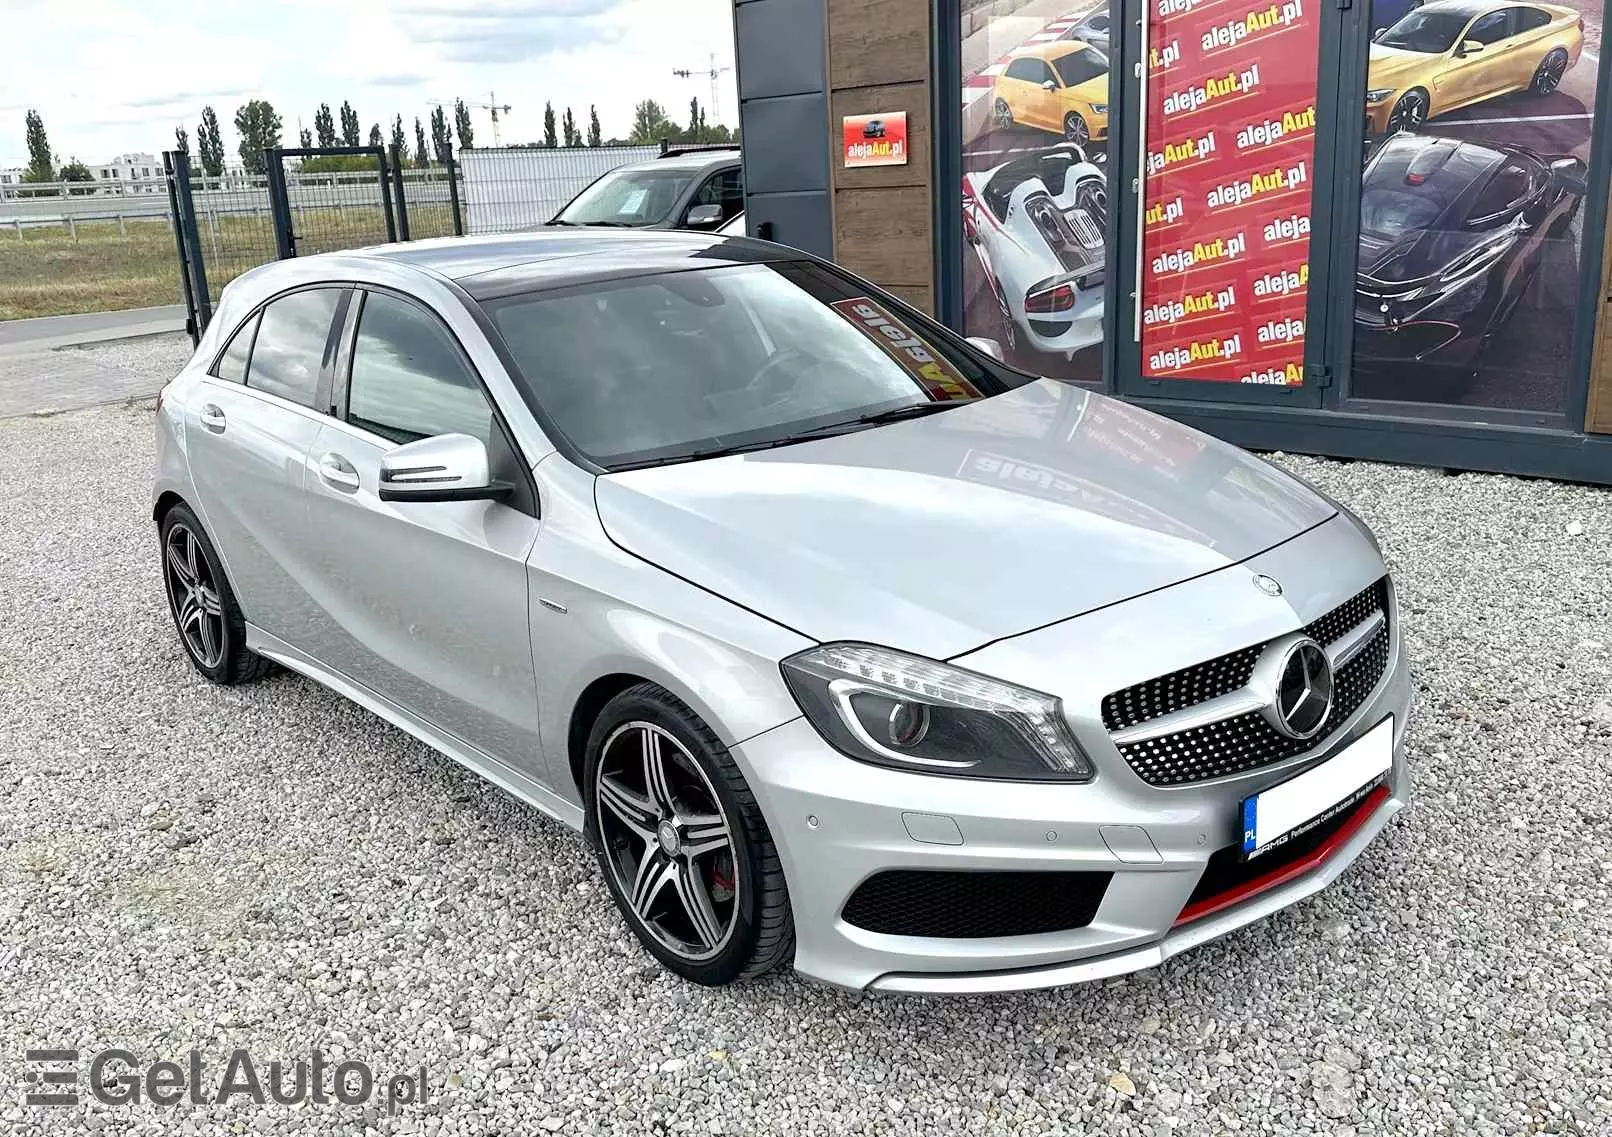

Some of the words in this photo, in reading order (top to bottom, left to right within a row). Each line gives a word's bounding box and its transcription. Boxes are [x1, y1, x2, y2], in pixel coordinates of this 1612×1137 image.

[1201, 0, 1302, 50] alejaAut.pl
[1163, 64, 1260, 115] alejaAut.pl
[1236, 106, 1316, 148] alejaAut
[848, 139, 903, 160] alejaAut.pl
[1207, 161, 1307, 208] alejaAut.pl
[1263, 214, 1311, 242] aleja
[1152, 232, 1246, 274] alejaAut.pl
[1143, 286, 1235, 325] alejaAut.pl
[1149, 334, 1241, 370] alejaAut.pl
[1244, 829, 1256, 843] PL
